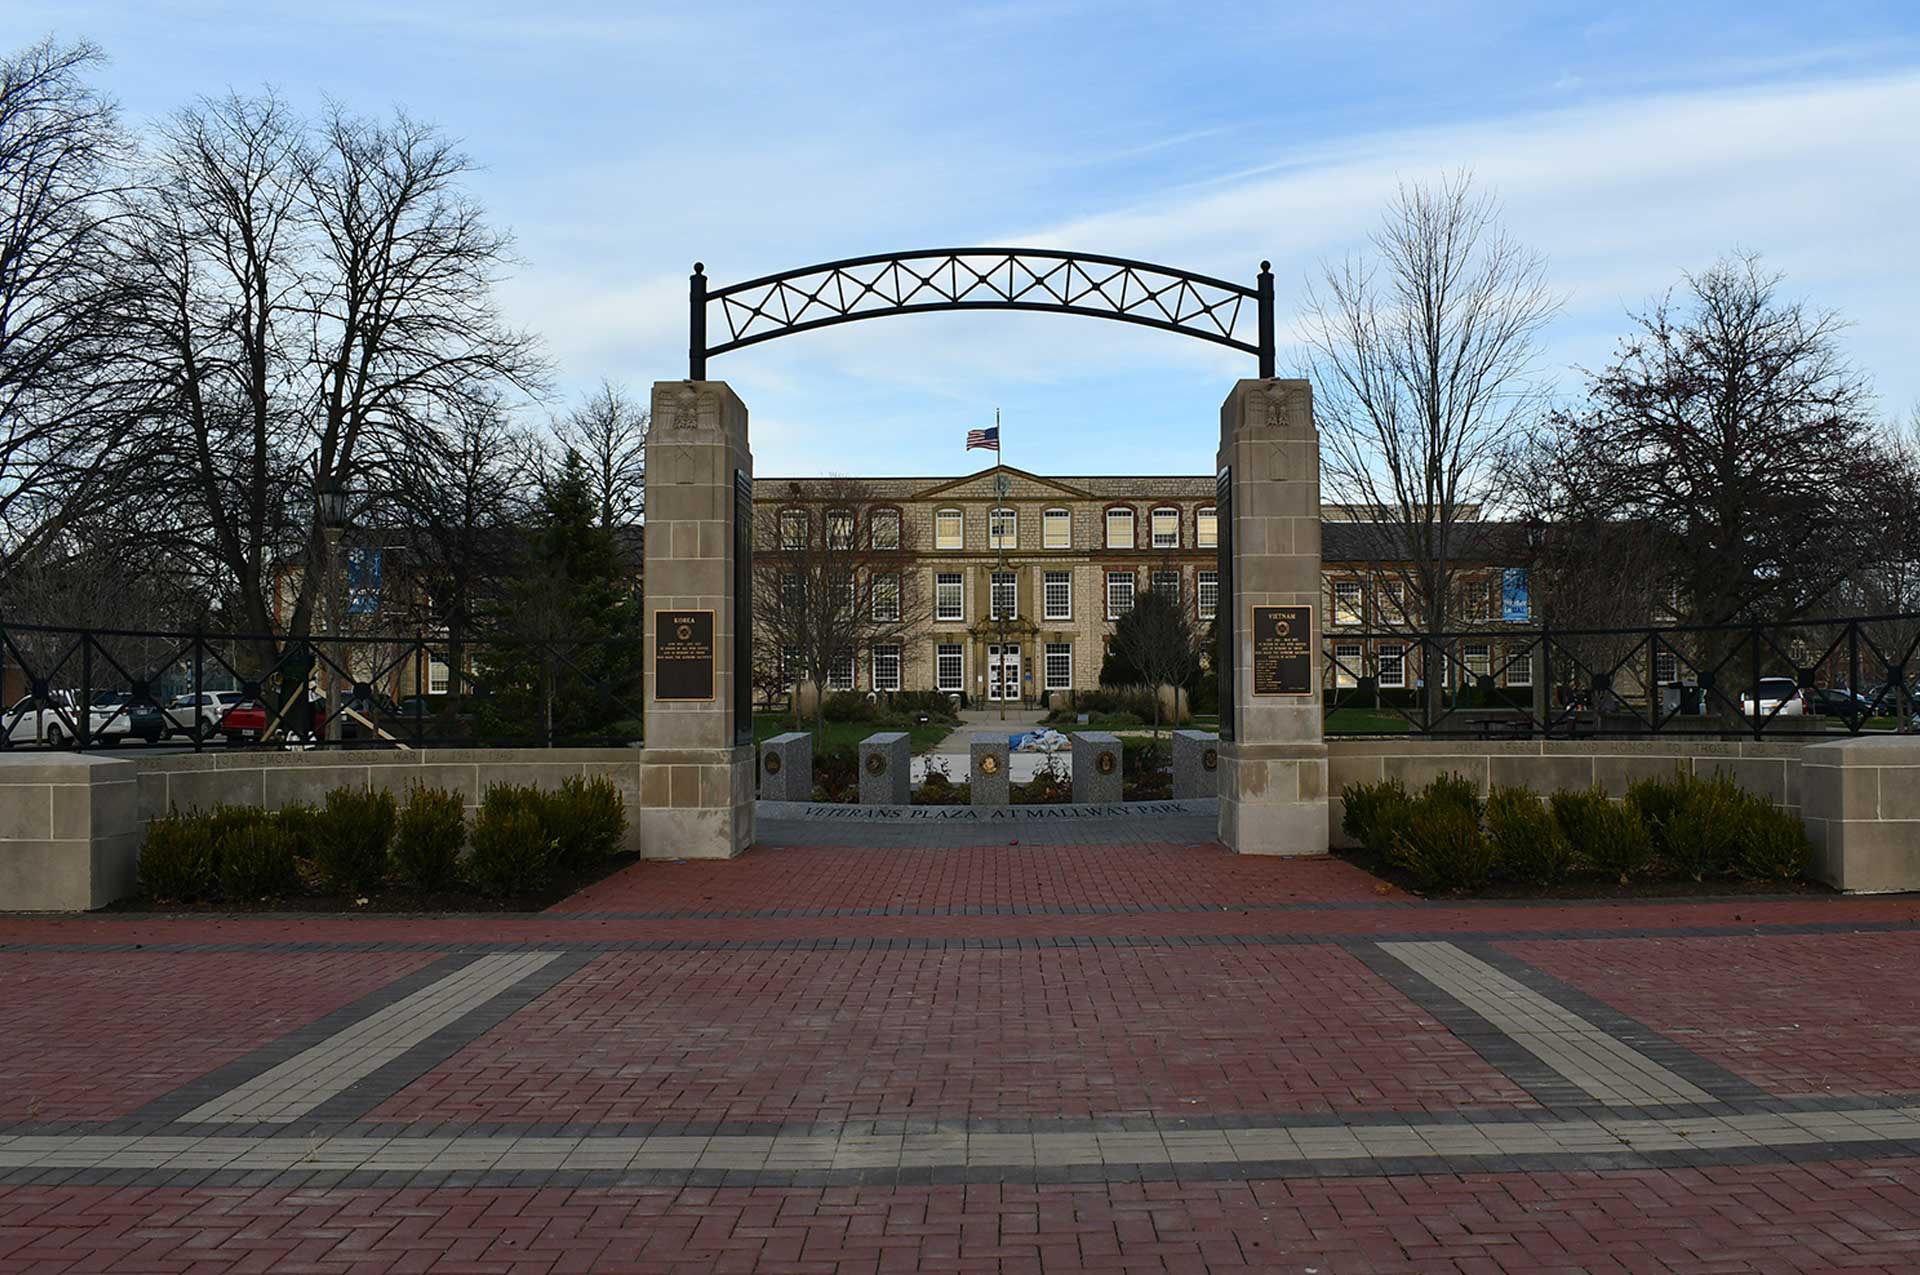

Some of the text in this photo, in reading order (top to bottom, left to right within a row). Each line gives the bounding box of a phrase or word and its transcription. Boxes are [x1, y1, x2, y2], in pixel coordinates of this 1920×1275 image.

[1576, 742, 1600, 754] AND
[1611, 742, 1653, 754] HONOR
[1695, 743, 1730, 755] THOSE
[250, 752, 311, 766] MEMORIAL
[337, 751, 379, 763] WORLD
[392, 750, 417, 762] WAR
[805, 803, 1188, 820] VETERANS PLAZA AT MALLWAY PARK
